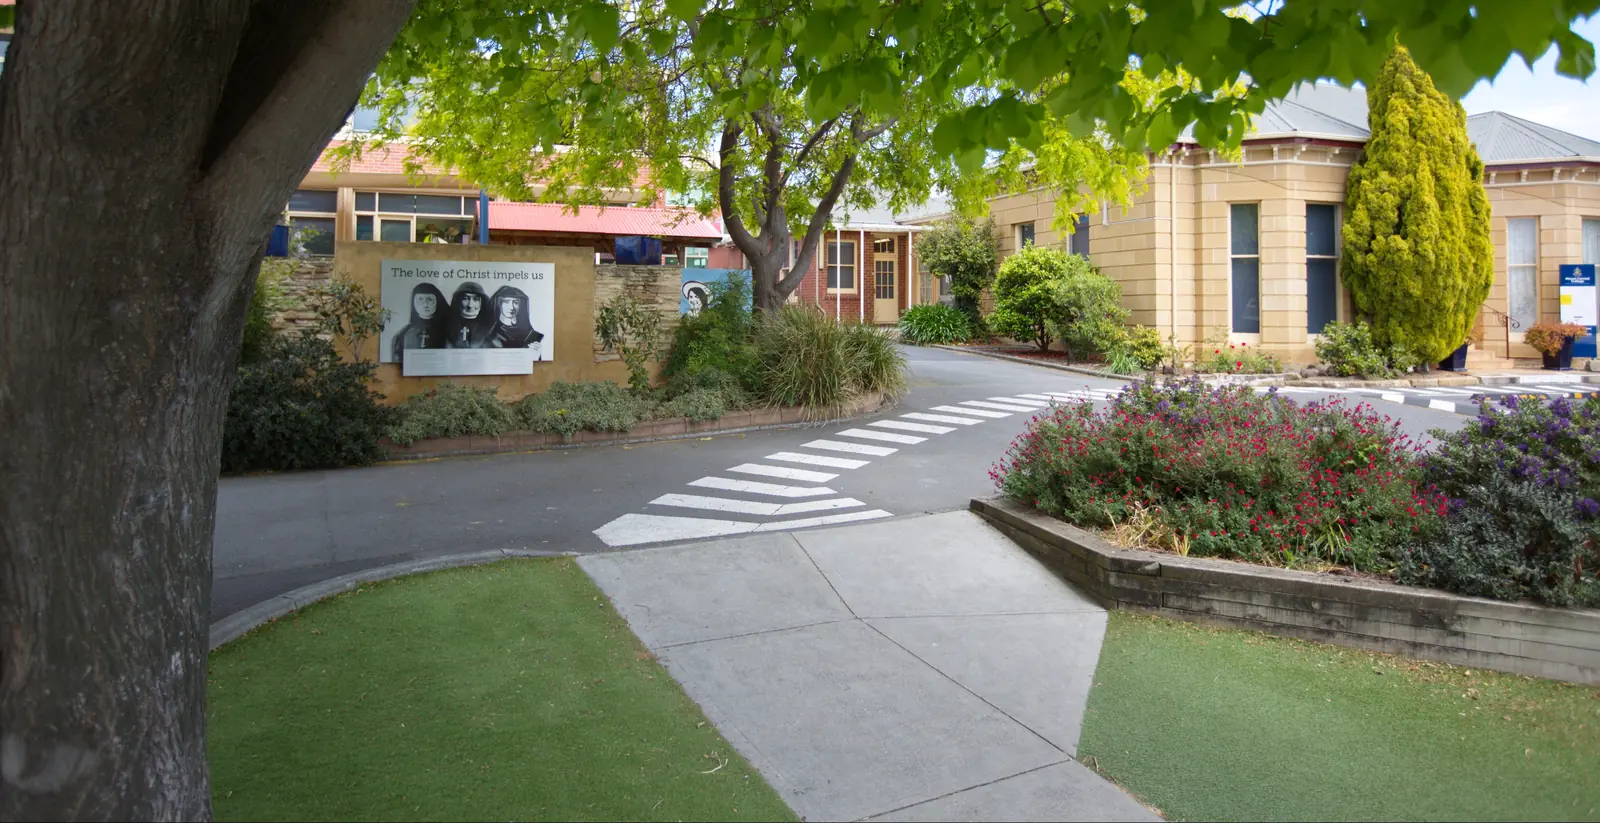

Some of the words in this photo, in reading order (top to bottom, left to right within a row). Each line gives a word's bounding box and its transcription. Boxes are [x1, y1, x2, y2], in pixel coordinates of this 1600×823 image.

[391, 267, 414, 278] The
[416, 268, 439, 278] love
[442, 269, 455, 278] of
[457, 269, 490, 279] Christ
[493, 270, 529, 281] impels
[532, 273, 544, 281] us
